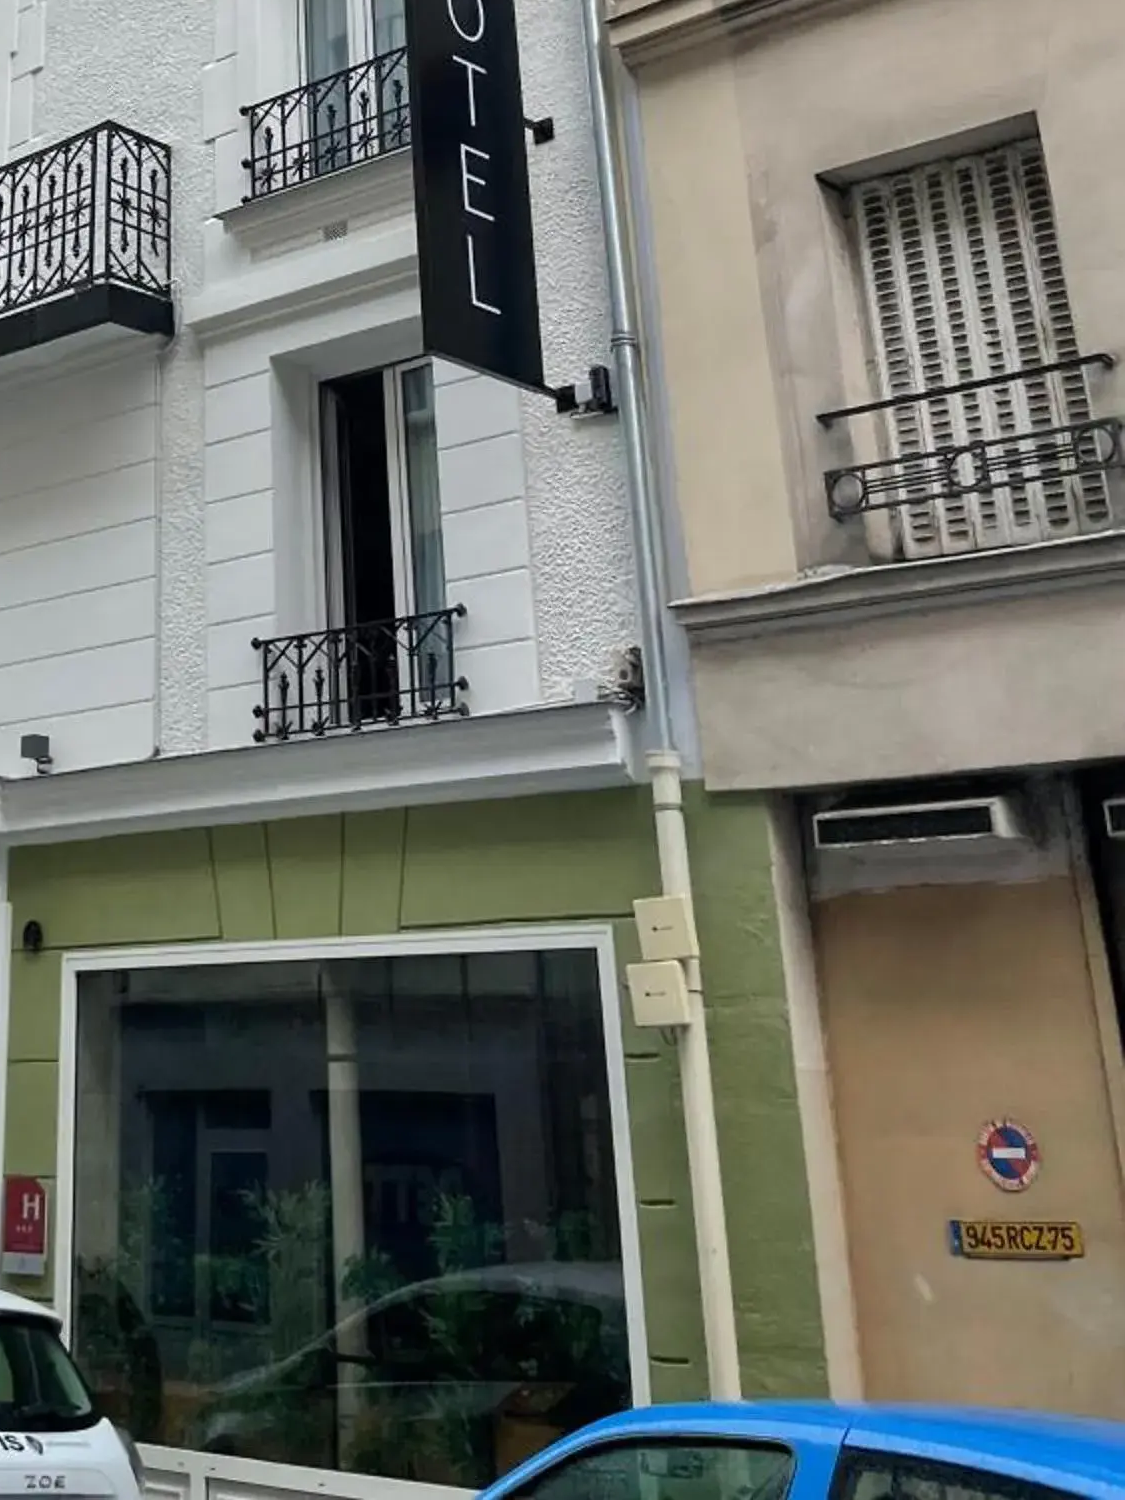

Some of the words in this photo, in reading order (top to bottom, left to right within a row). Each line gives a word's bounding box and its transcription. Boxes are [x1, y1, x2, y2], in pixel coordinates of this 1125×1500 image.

[22, 1192, 41, 1221] H
[965, 1225, 1075, 1252] 945RCZ75
[25, 1474, 66, 1489] ZOE
